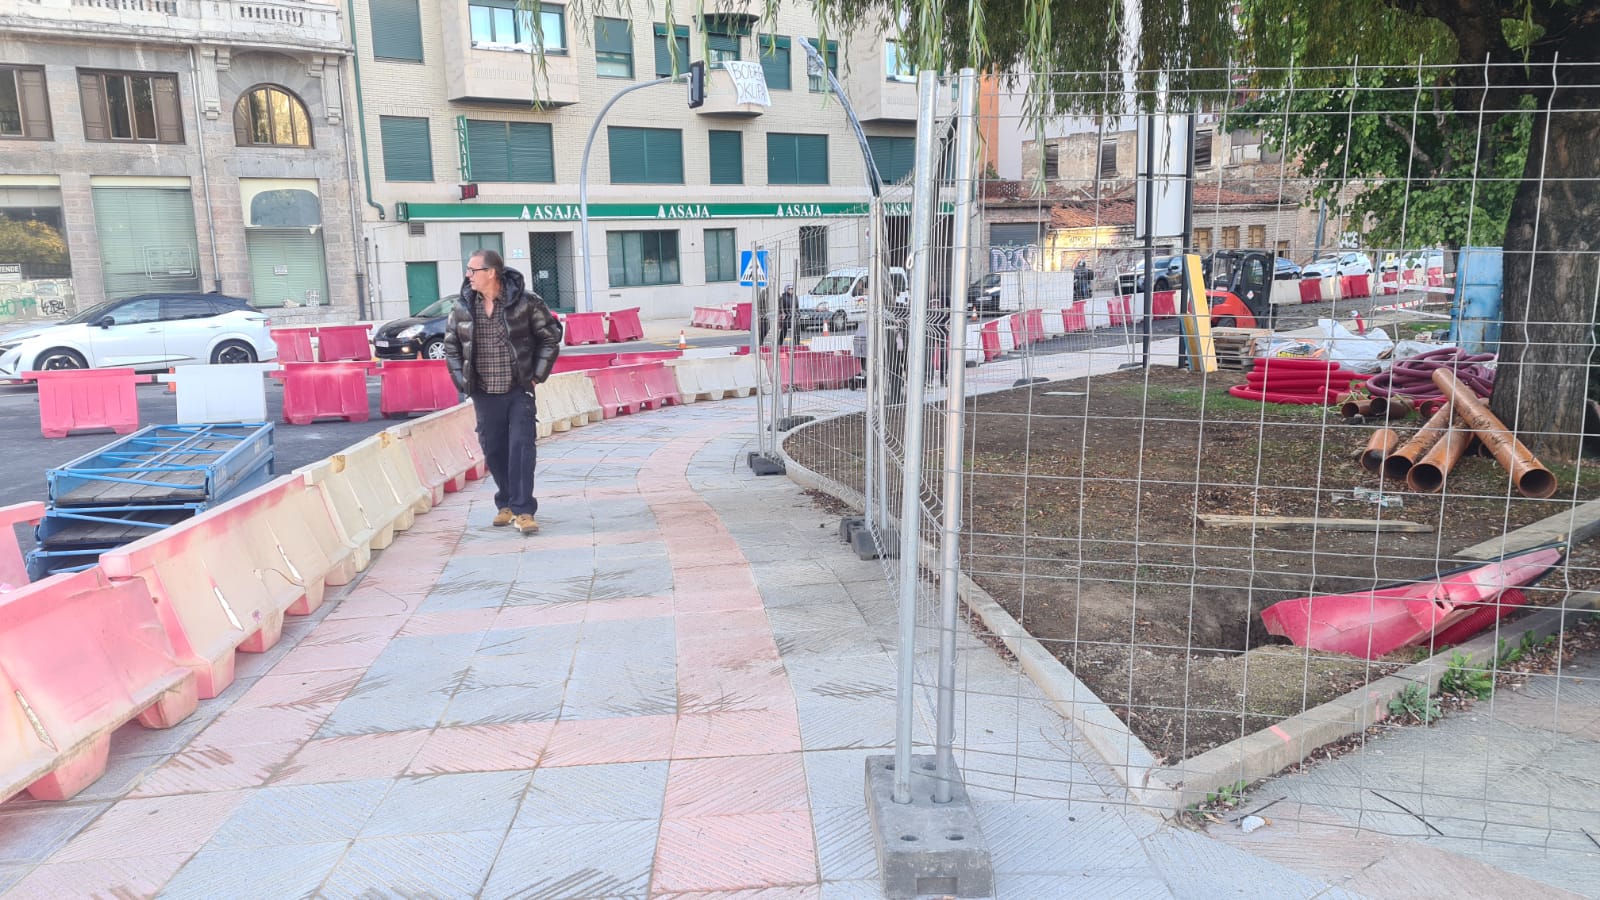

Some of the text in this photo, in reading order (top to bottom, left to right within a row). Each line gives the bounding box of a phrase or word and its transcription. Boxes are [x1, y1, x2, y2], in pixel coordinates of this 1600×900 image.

[459, 118, 469, 179] ASAJA
[534, 205, 582, 220] ASAJA
[668, 204, 711, 218] ASAJA
[785, 204, 822, 217] ASAJA
